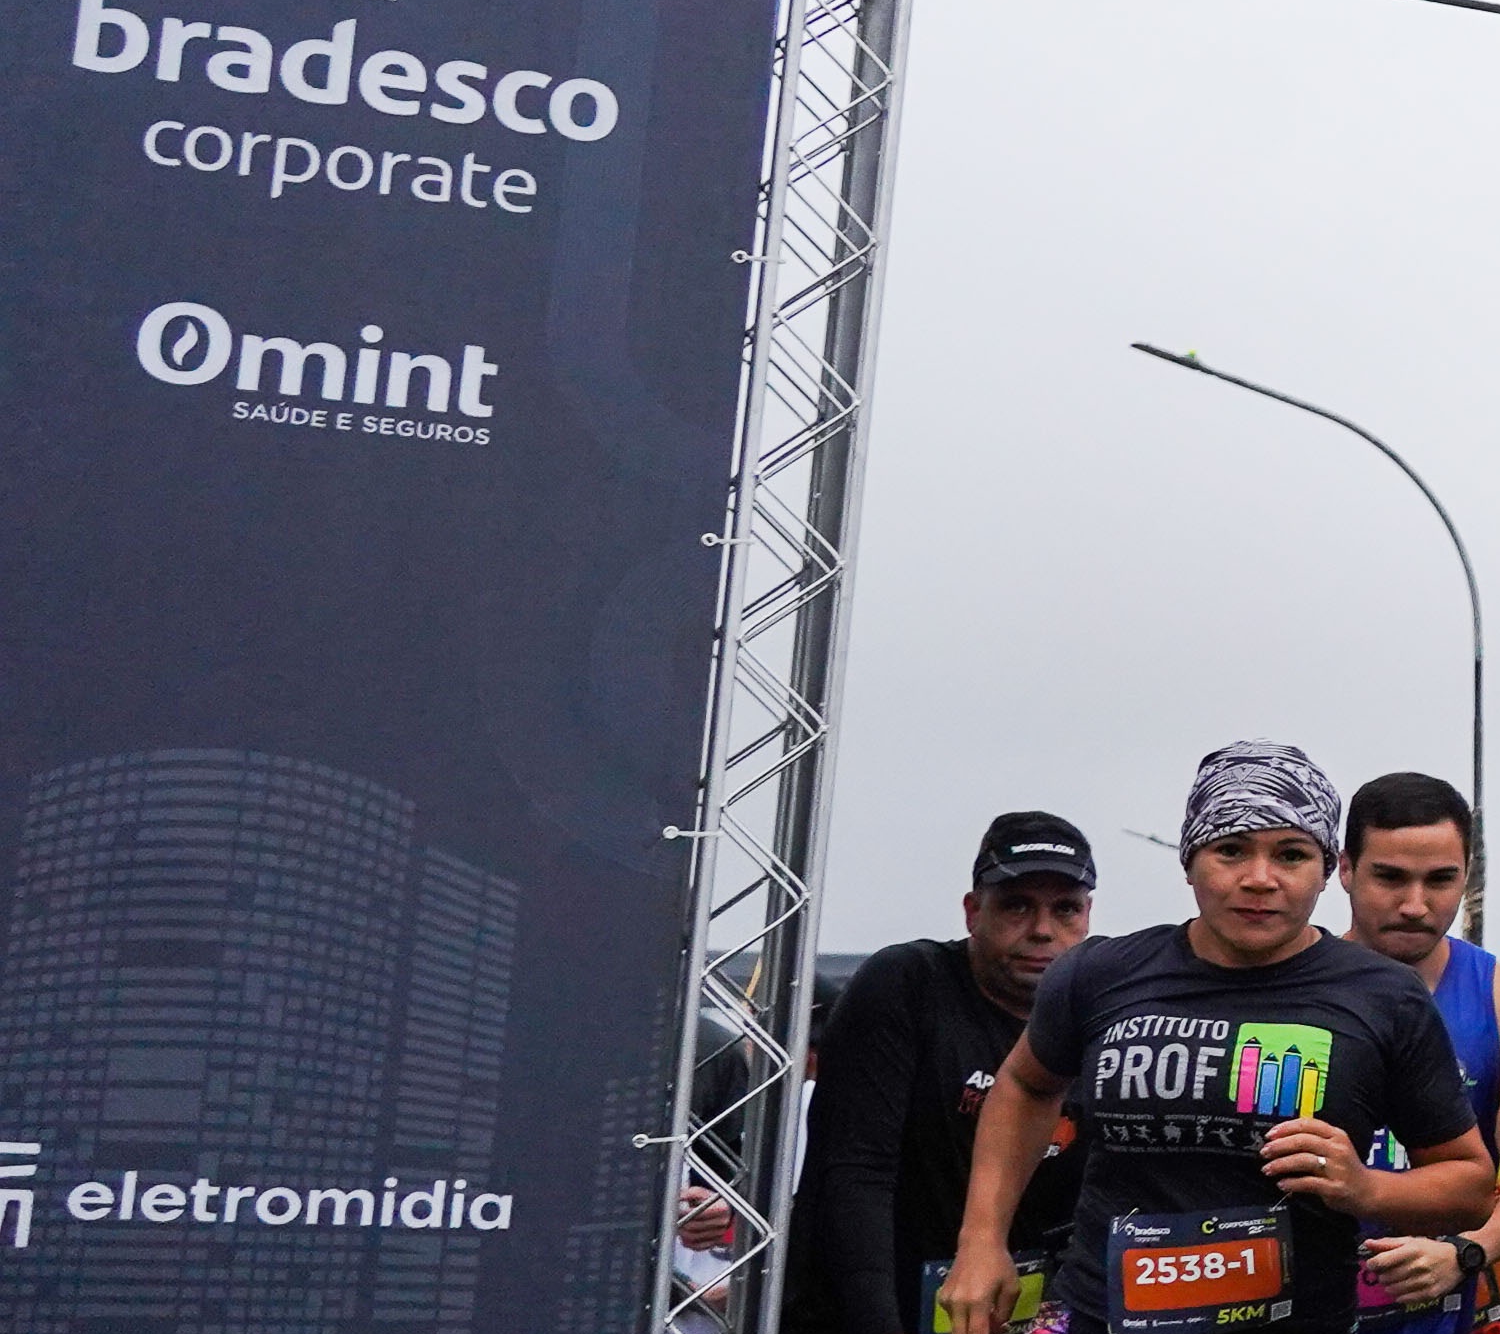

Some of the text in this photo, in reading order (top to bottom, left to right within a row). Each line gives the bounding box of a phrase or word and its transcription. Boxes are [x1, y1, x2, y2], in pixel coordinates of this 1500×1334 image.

[143, 120, 537, 213] corporate
[137, 302, 499, 417] Omint
[233, 402, 490, 445] SAÚDE E SEGUROS
[1104, 1016, 1229, 1044] INSTITUTO
[1095, 1044, 1226, 1100] PROF
[67, 1172, 513, 1230] eletromidia
[1135, 1227, 1171, 1236] bradesco
[1136, 1249, 1255, 1285] 2538-1
[1216, 1304, 1266, 1325] 5KM
